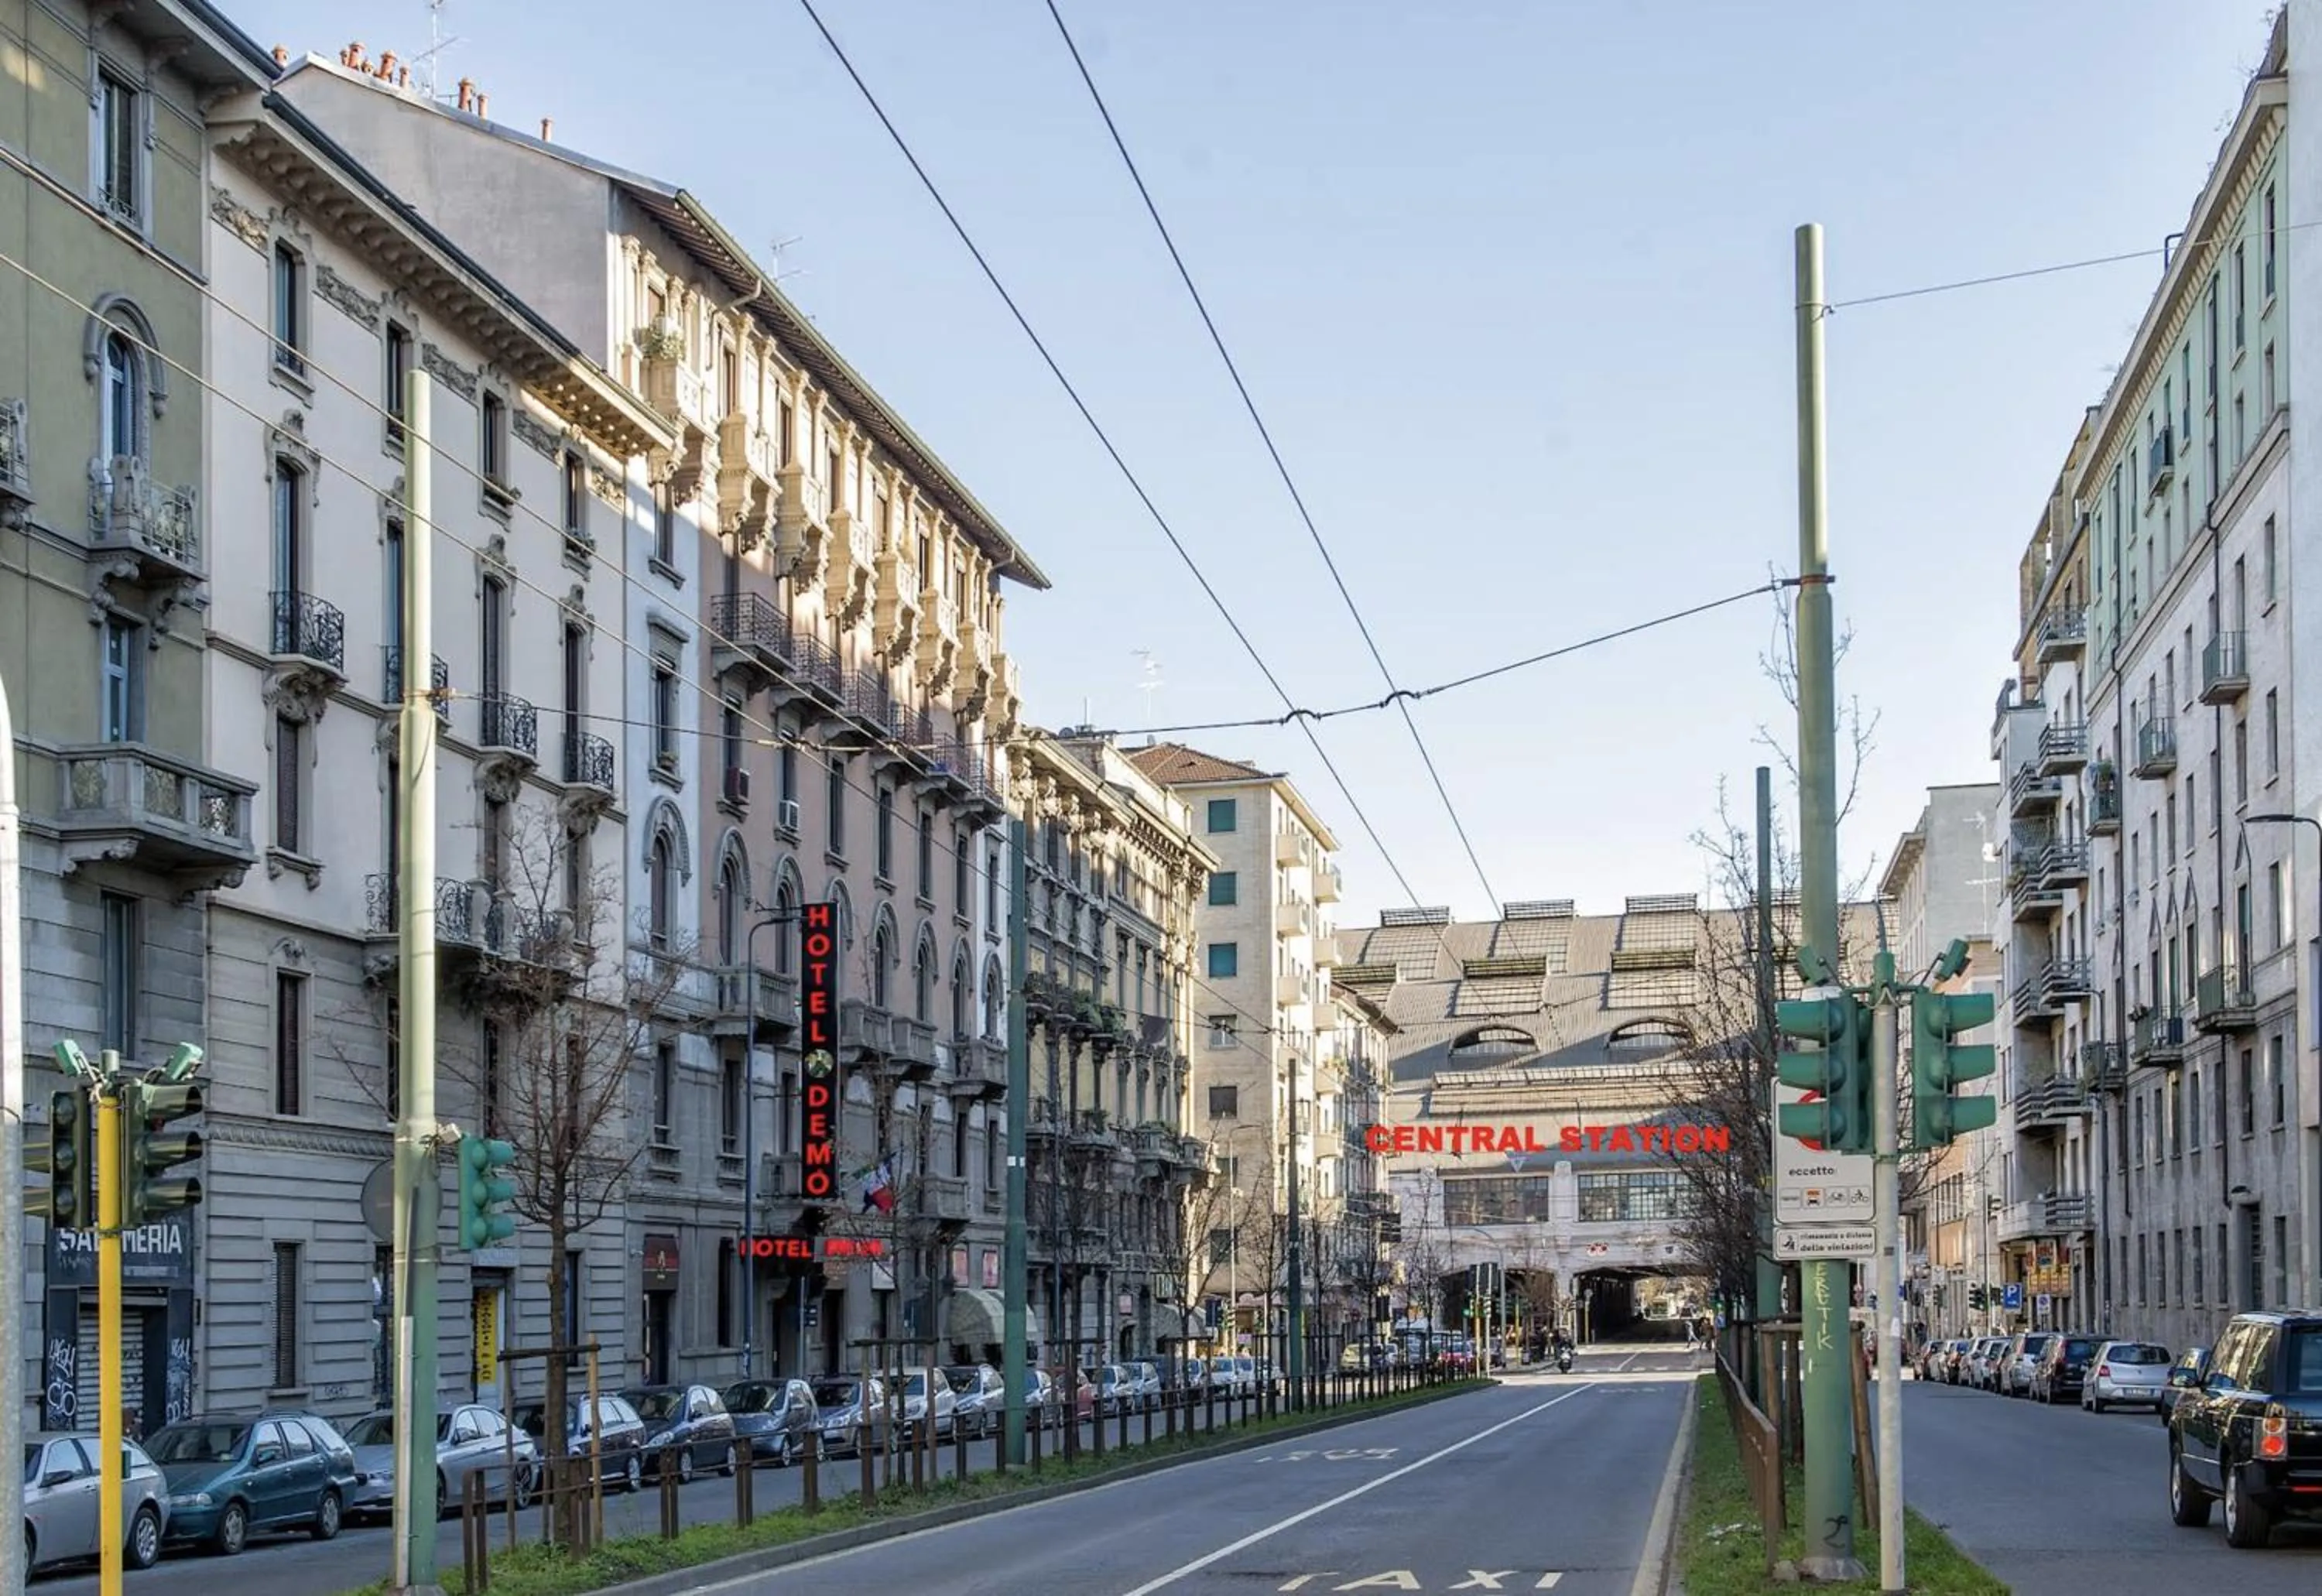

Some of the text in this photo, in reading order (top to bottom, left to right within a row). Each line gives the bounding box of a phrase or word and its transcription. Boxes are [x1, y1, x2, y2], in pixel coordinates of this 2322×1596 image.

[807, 906, 831, 1043] HOTEL
[1788, 1166, 1835, 1176] eccetto
[59, 1224, 183, 1254] SALMERIA
[2007, 1285, 2017, 1297] P
[1277, 1570, 1563, 1591] TAXI
